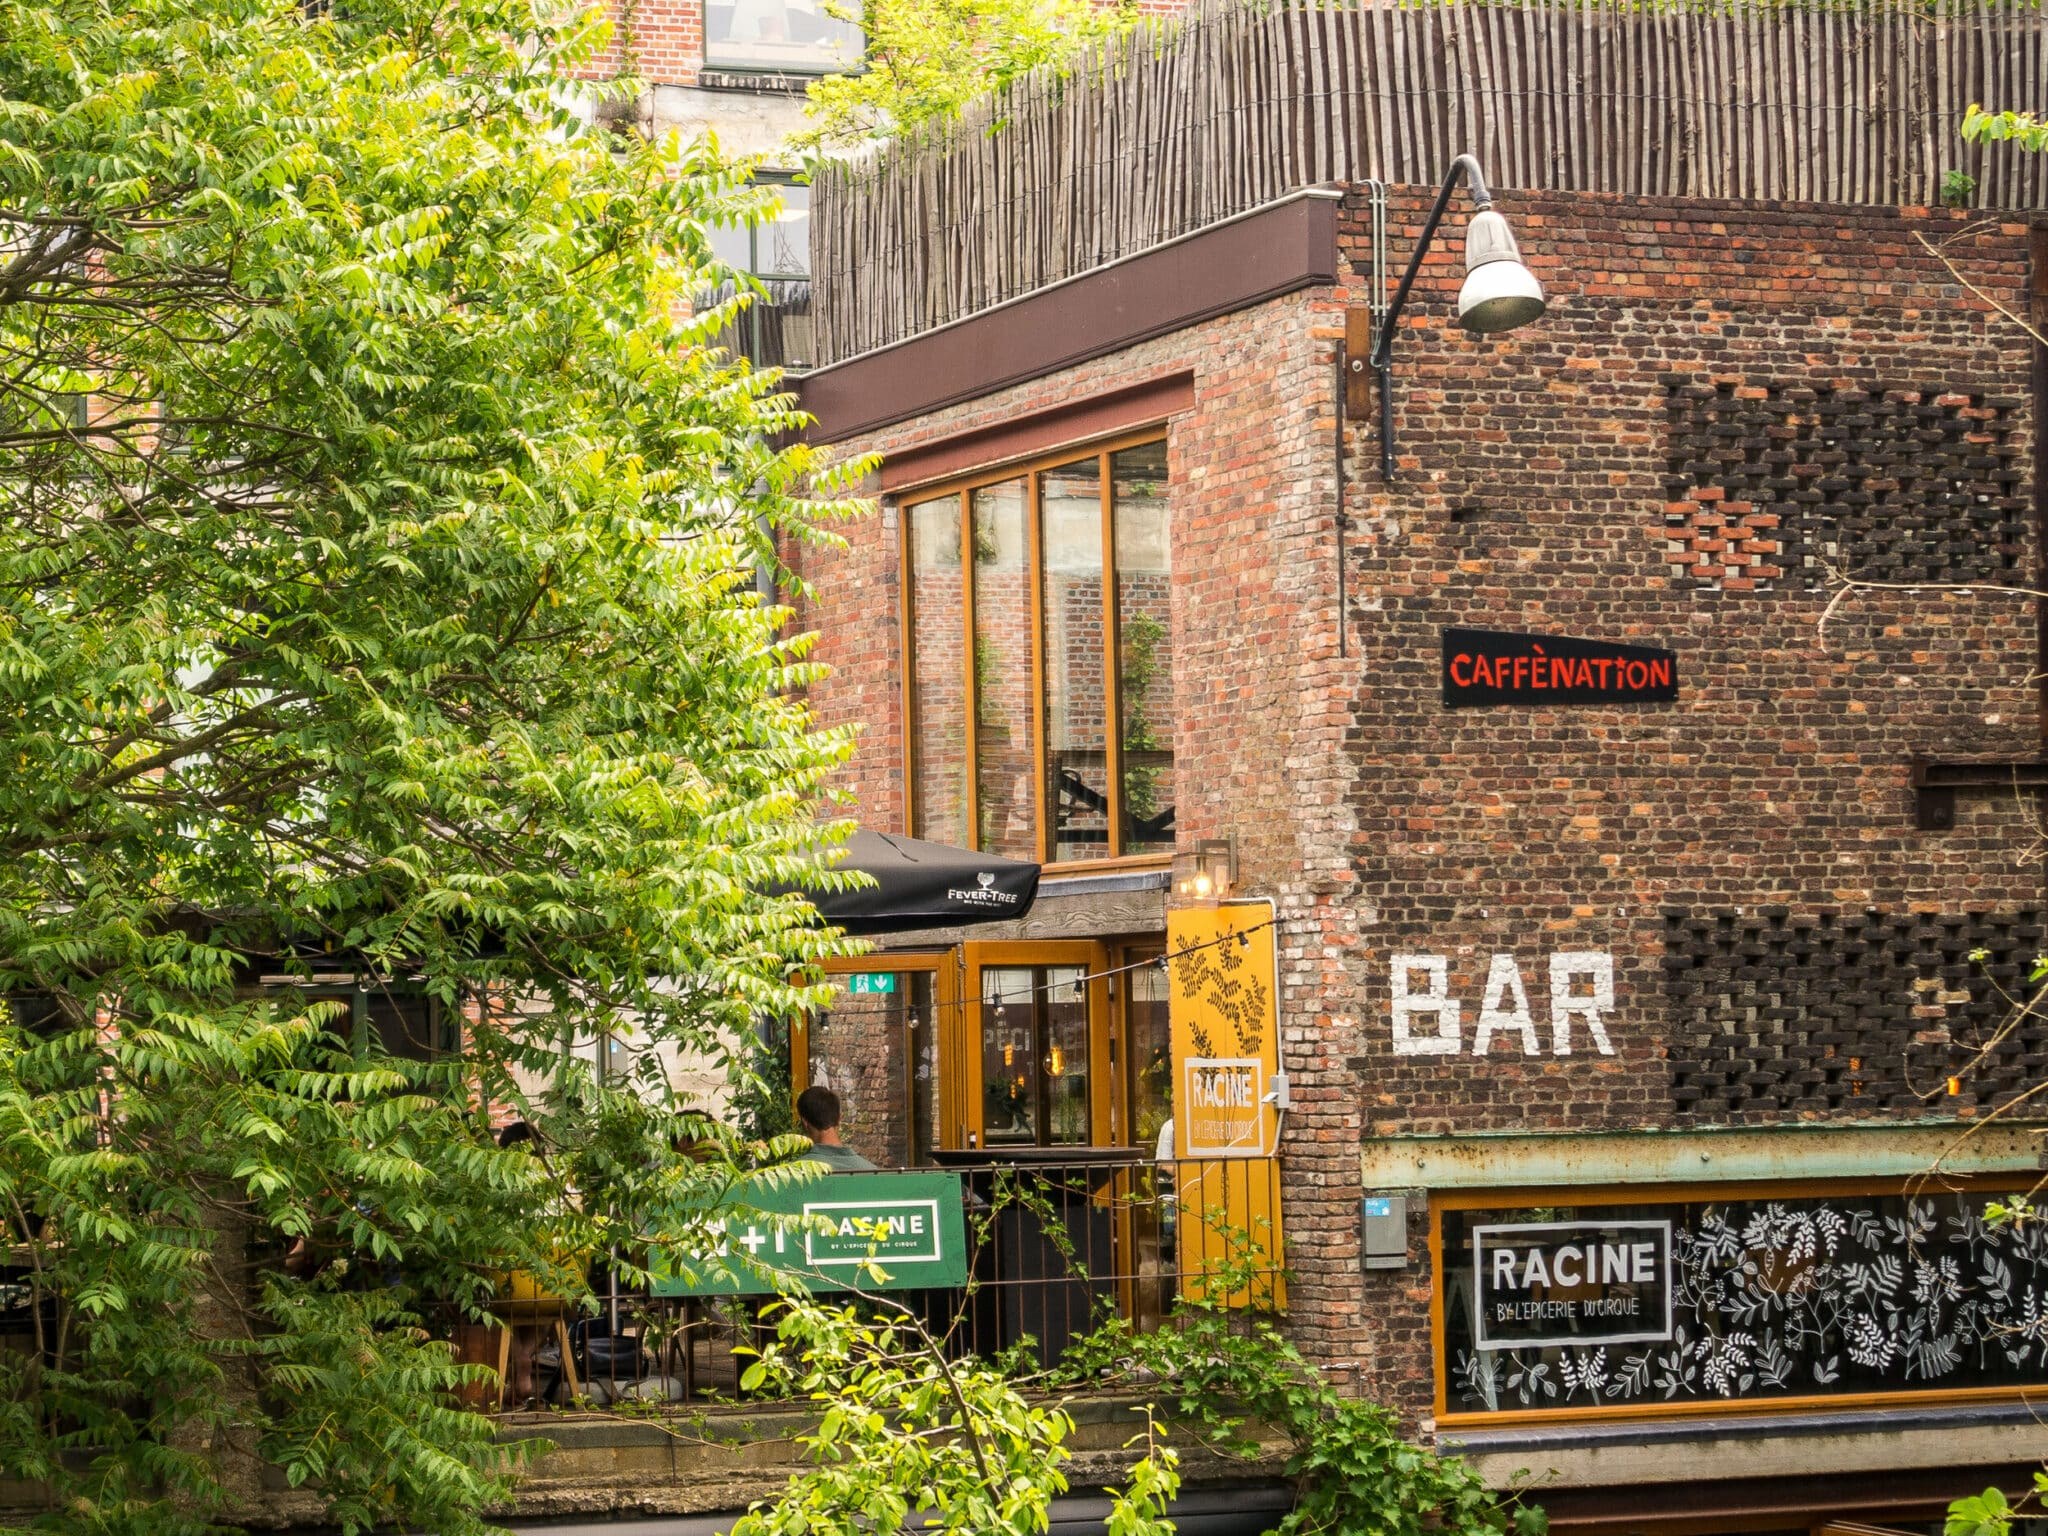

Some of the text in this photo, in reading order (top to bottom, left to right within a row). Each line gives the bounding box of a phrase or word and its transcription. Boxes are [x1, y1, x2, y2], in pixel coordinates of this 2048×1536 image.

[1389, 951, 1616, 1056] BAR
[1192, 1071, 1253, 1108] RACINE
[1493, 1242, 1655, 1290] RACINE
[1497, 1297, 1640, 1322] BY L'EPICERIE DU CIRQUE
